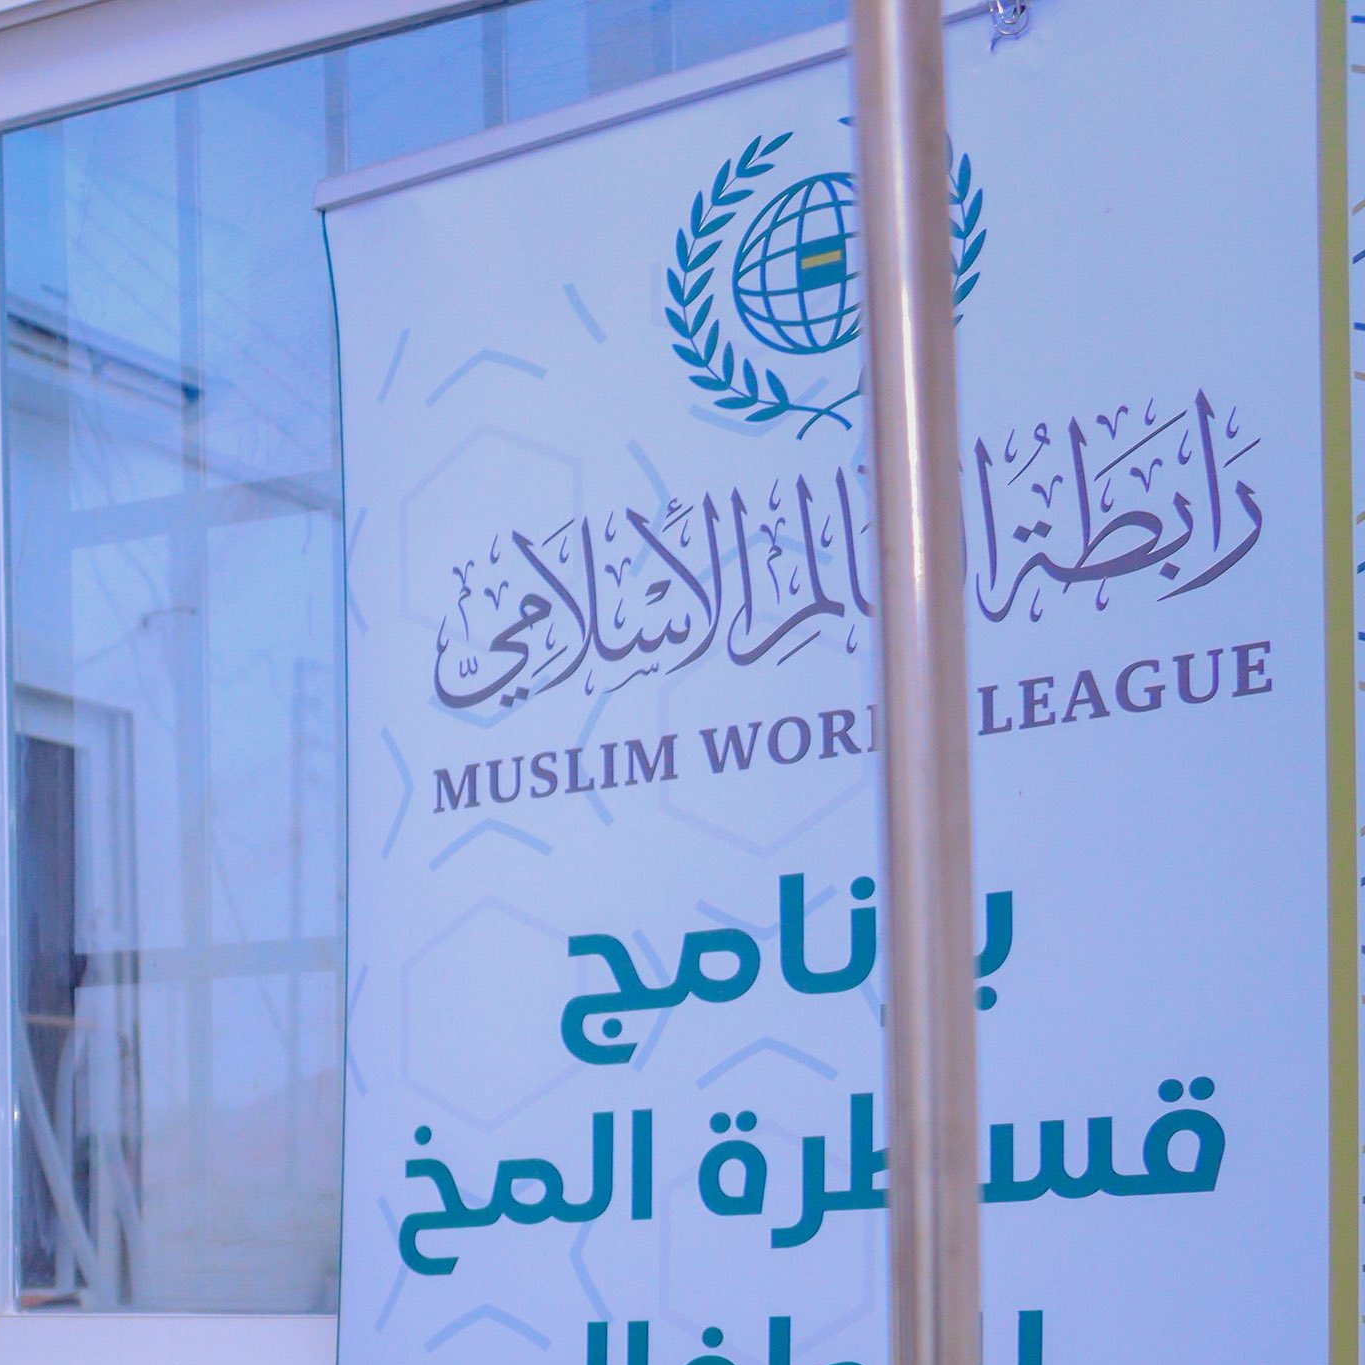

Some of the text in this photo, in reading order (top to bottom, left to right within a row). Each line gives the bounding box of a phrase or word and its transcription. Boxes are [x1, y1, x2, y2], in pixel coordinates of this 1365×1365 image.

[433, 640, 1273, 814] MUSLIM WOR LEAGUE
[561, 872, 1013, 1066] بنامج
[398, 1108, 653, 1277] المخ
